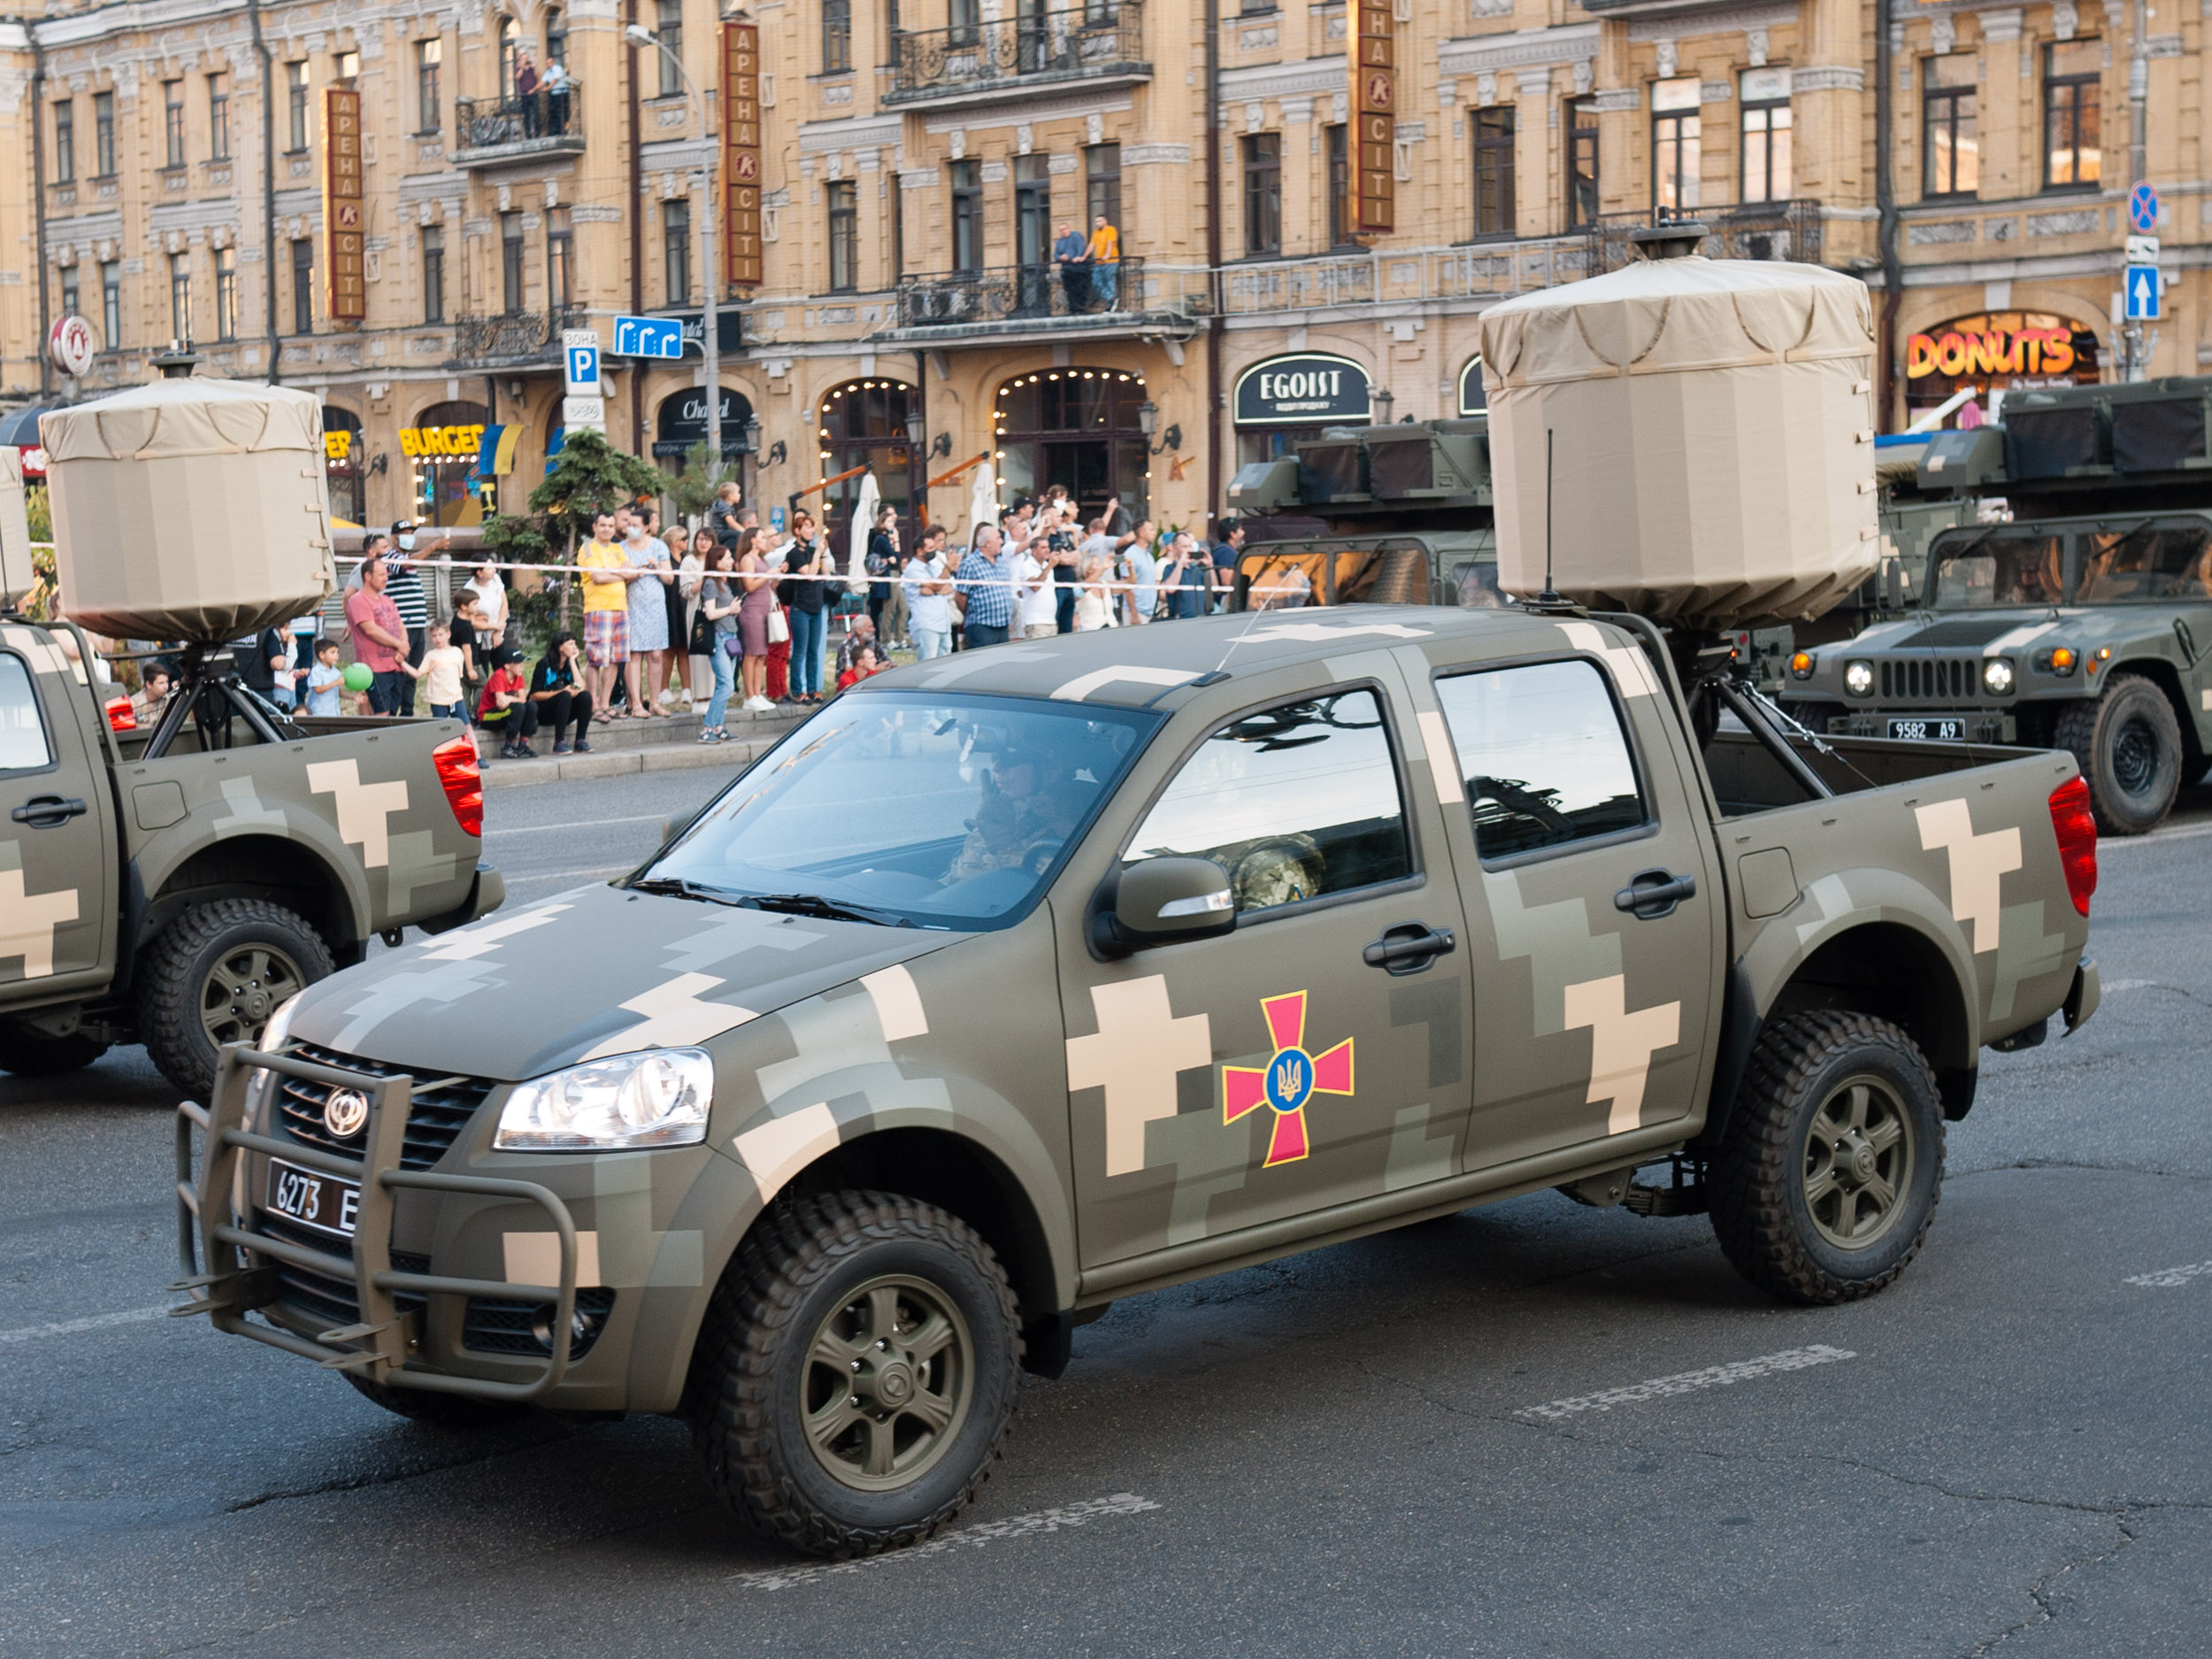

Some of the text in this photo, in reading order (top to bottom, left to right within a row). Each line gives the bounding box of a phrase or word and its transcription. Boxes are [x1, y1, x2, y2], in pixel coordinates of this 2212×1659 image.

[566, 334, 597, 345] ЗОНА
[1908, 328, 2074, 378] DONUTS
[1260, 370, 1342, 400] EGOIST
[682, 398, 730, 420] Chaal
[1895, 722, 1956, 739] 9582 A9
[277, 1171, 321, 1219] 6273
